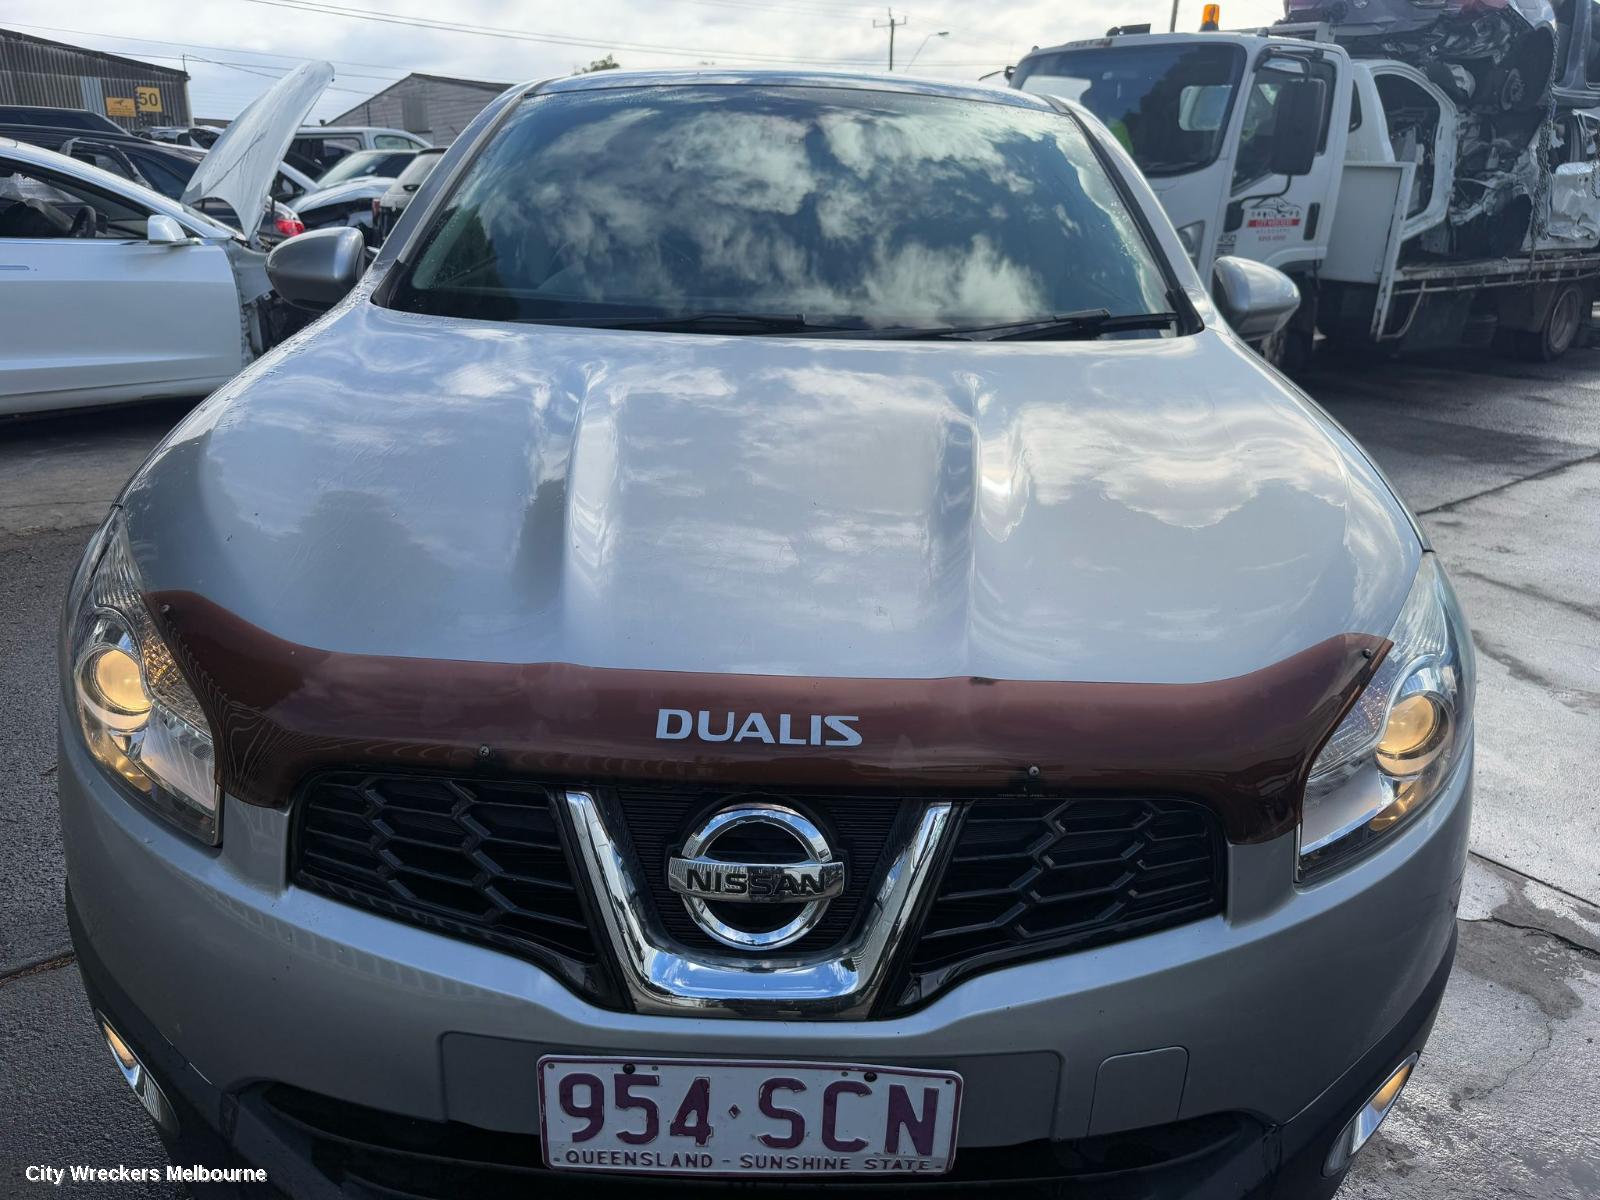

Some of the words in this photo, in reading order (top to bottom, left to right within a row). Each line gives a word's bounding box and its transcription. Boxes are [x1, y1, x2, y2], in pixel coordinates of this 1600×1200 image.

[139, 92, 158, 106] 50
[655, 708, 863, 747] DUALIS
[686, 868, 826, 896] NISSAN
[565, 1149, 713, 1168] QUEENSLAND
[739, 1155, 850, 1170] SUNSHINE
[863, 1157, 931, 1170] STATE
